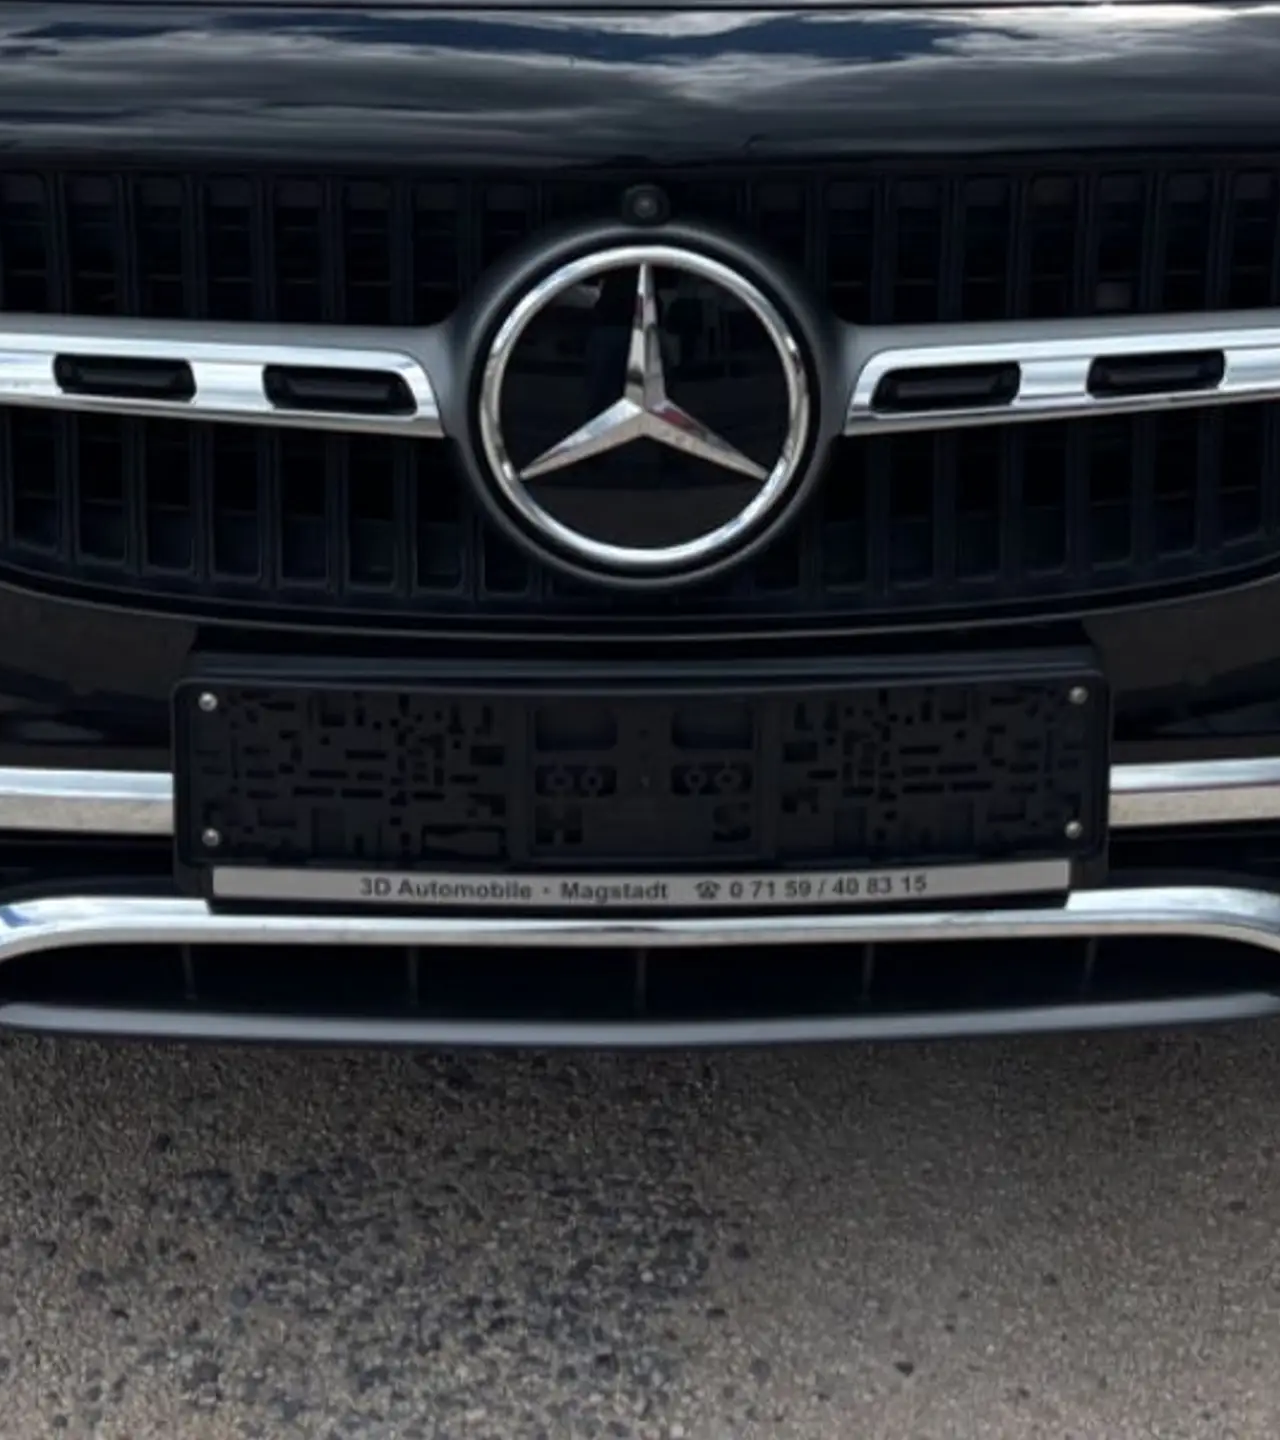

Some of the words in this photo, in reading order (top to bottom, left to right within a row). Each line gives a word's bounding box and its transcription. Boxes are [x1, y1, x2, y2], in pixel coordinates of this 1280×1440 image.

[359, 876, 391, 898] 3D
[397, 877, 532, 901] Automobile
[560, 881, 668, 904] Magstadt
[729, 880, 744, 899] 0
[751, 879, 775, 898] 71
[784, 879, 812, 898] 59
[832, 876, 860, 897] 40
[866, 875, 892, 896] 83
[901, 873, 928, 894] 15
